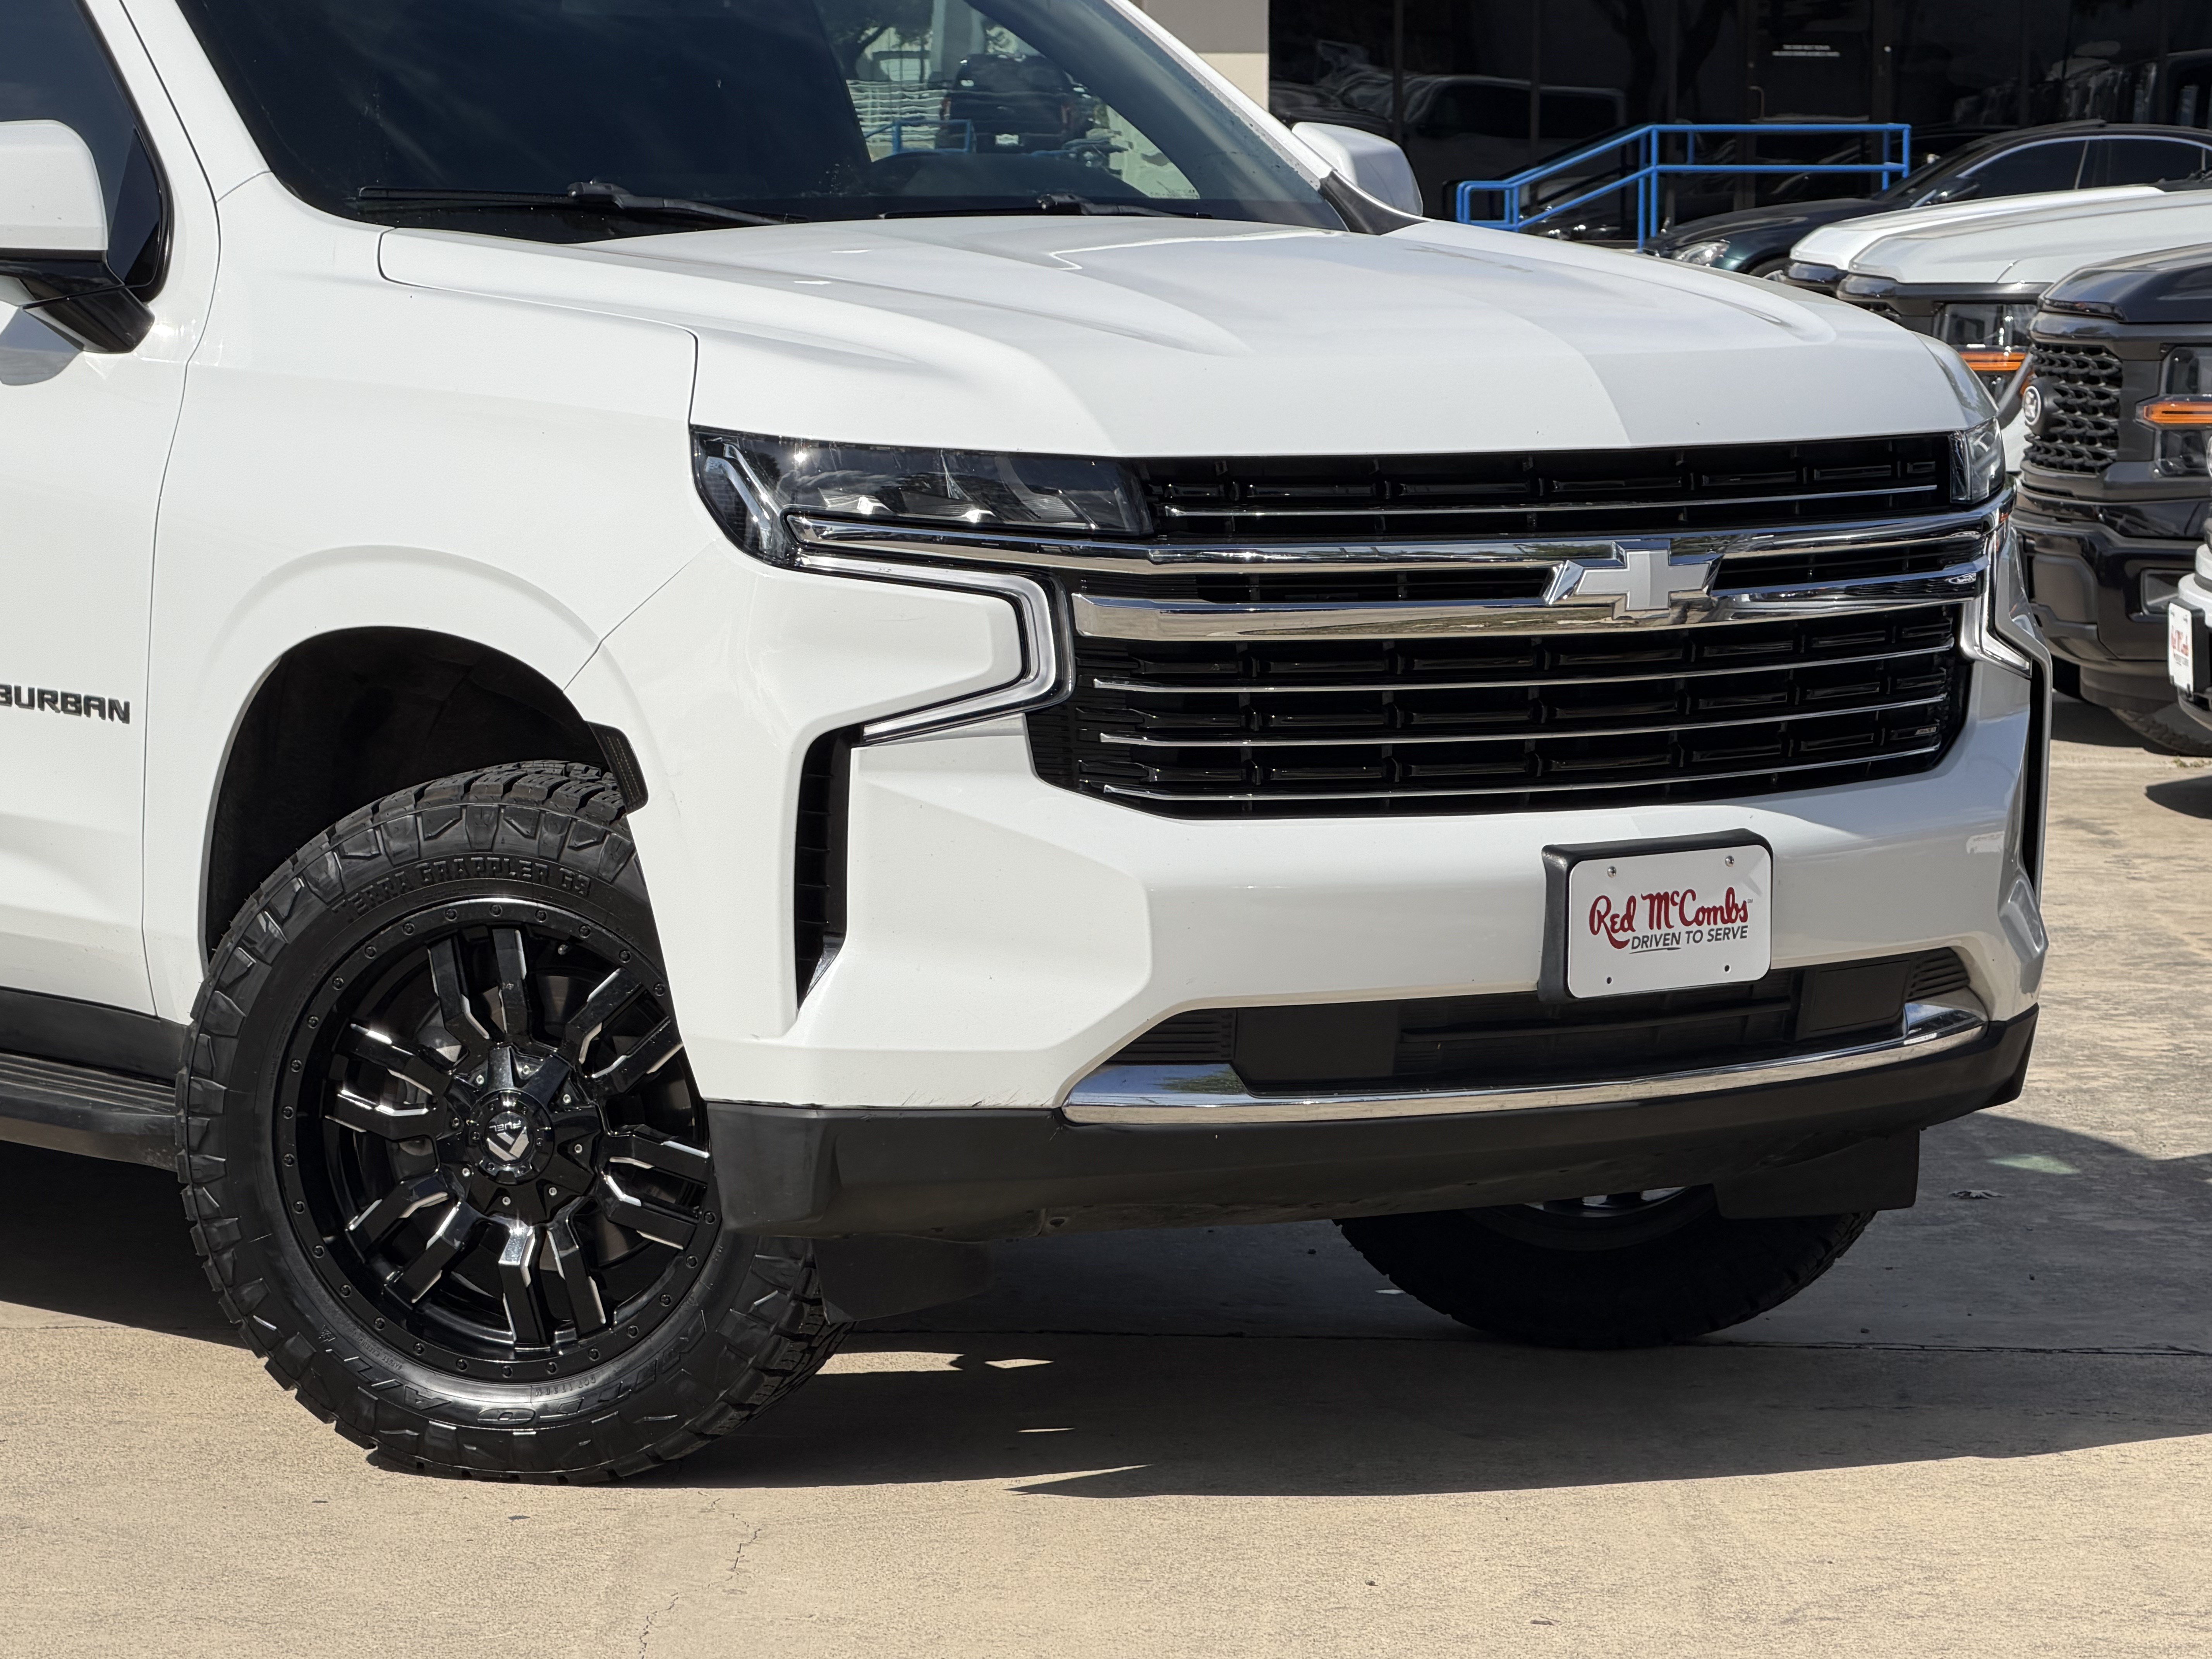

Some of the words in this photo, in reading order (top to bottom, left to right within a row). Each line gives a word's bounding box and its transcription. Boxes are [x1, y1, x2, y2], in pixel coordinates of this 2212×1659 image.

[332, 871, 412, 923] TERRA
[415, 855, 551, 882] GRAPPLER
[1589, 895, 1637, 950] Red
[1641, 886, 1749, 930] McCombs
[1631, 931, 1681, 950] DRIVEN
[1685, 929, 1704, 944] TO
[1707, 925, 1748, 943] SERVE
